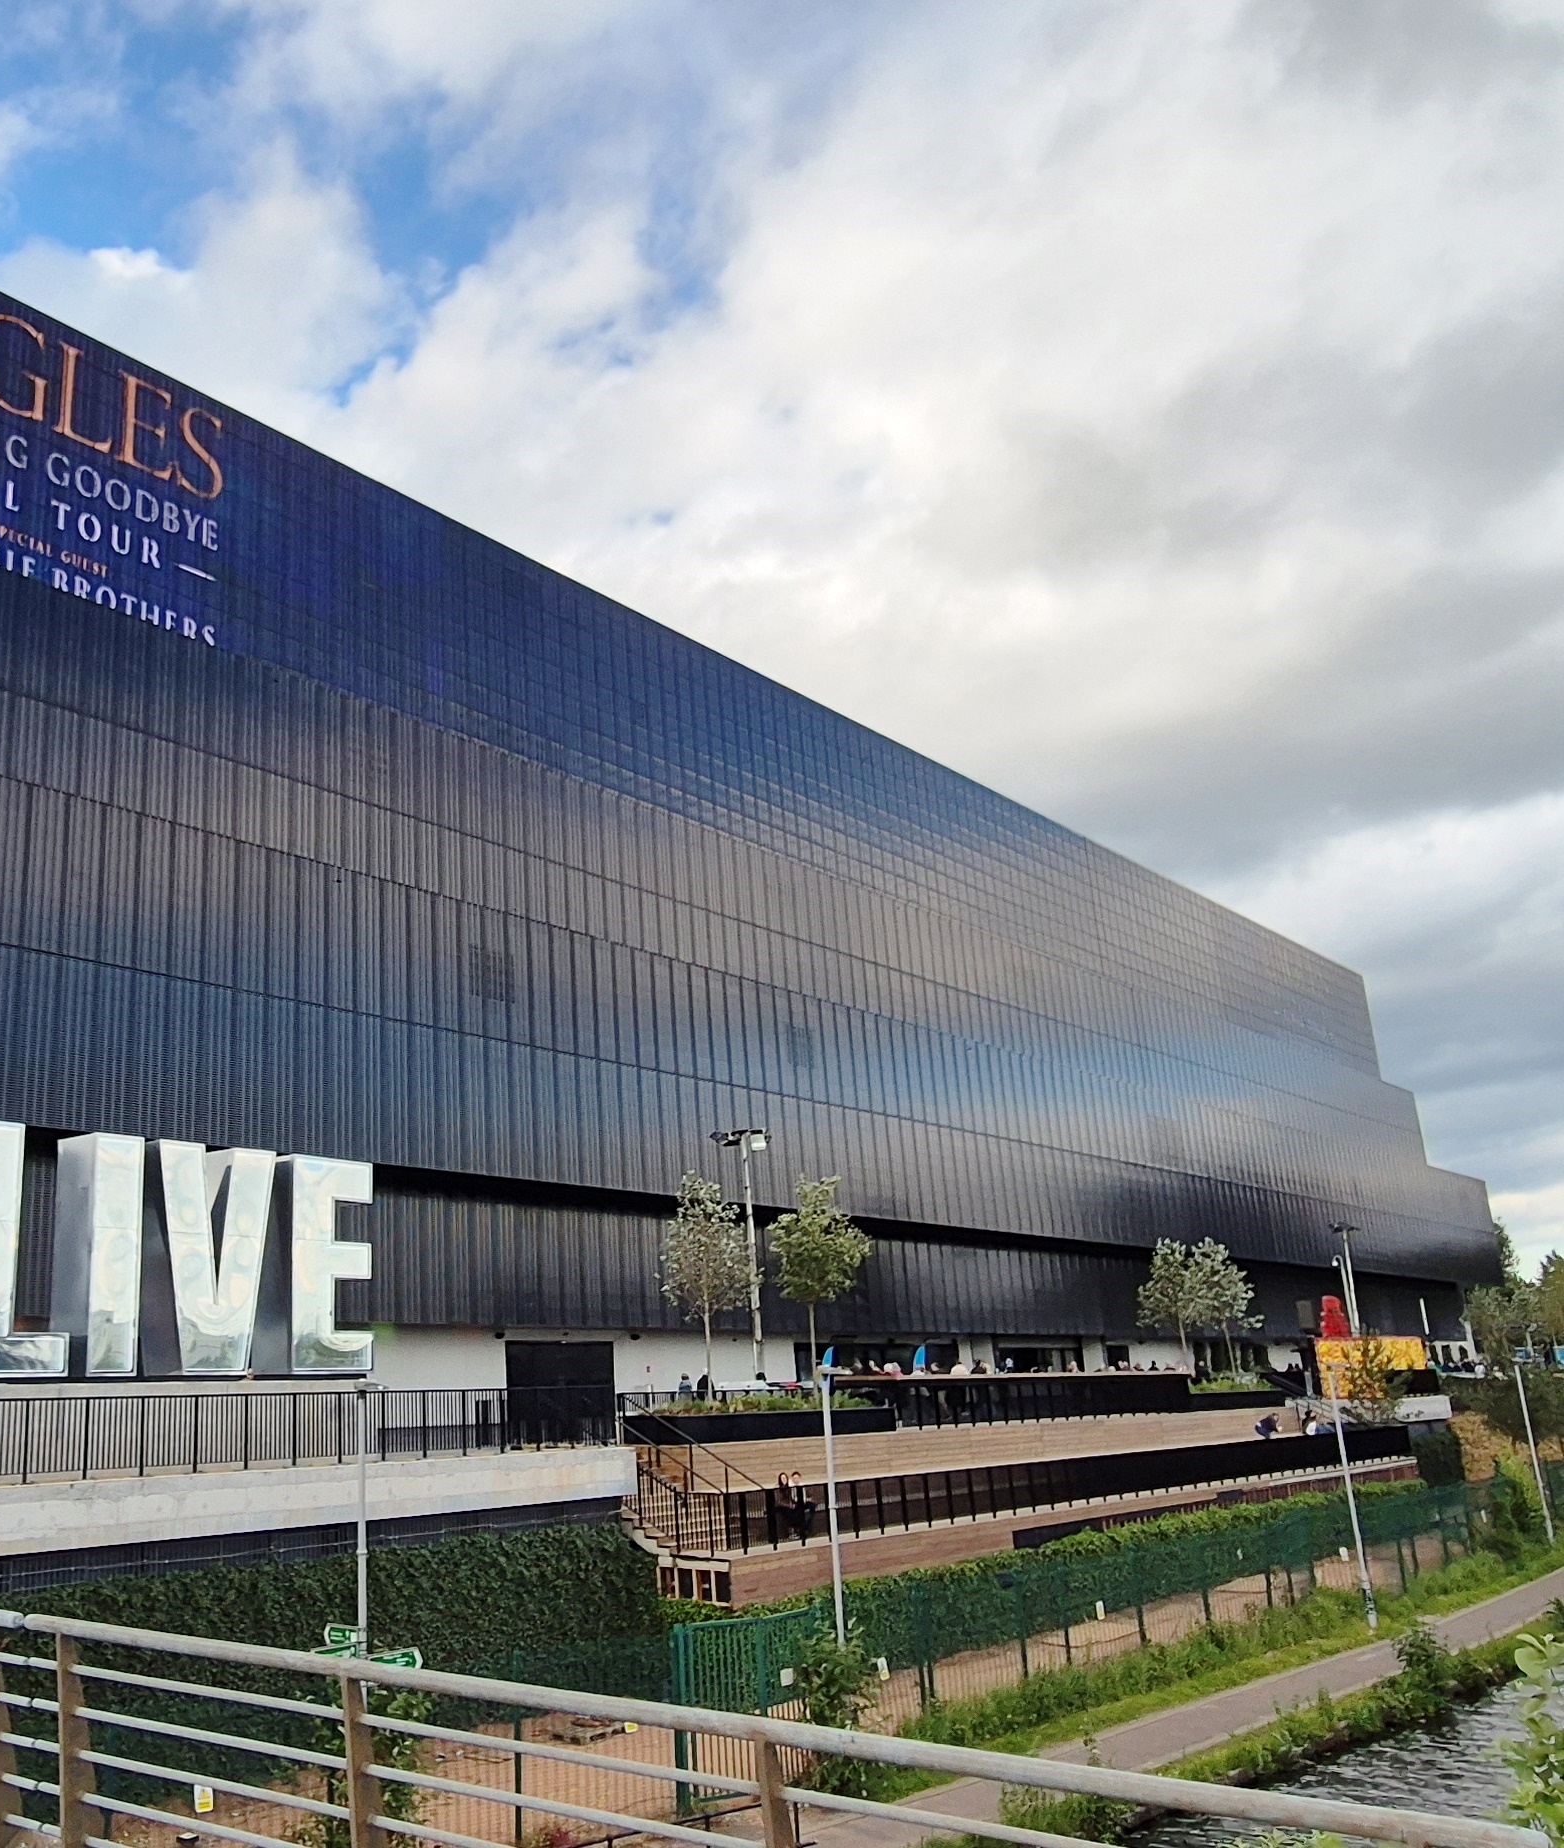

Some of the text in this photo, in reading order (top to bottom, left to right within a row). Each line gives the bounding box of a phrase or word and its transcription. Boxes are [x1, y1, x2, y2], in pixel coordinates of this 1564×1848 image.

[46, 452, 219, 551] GOODBYE
[50, 498, 161, 569] TOUR
[60, 550, 108, 579] GUEST
